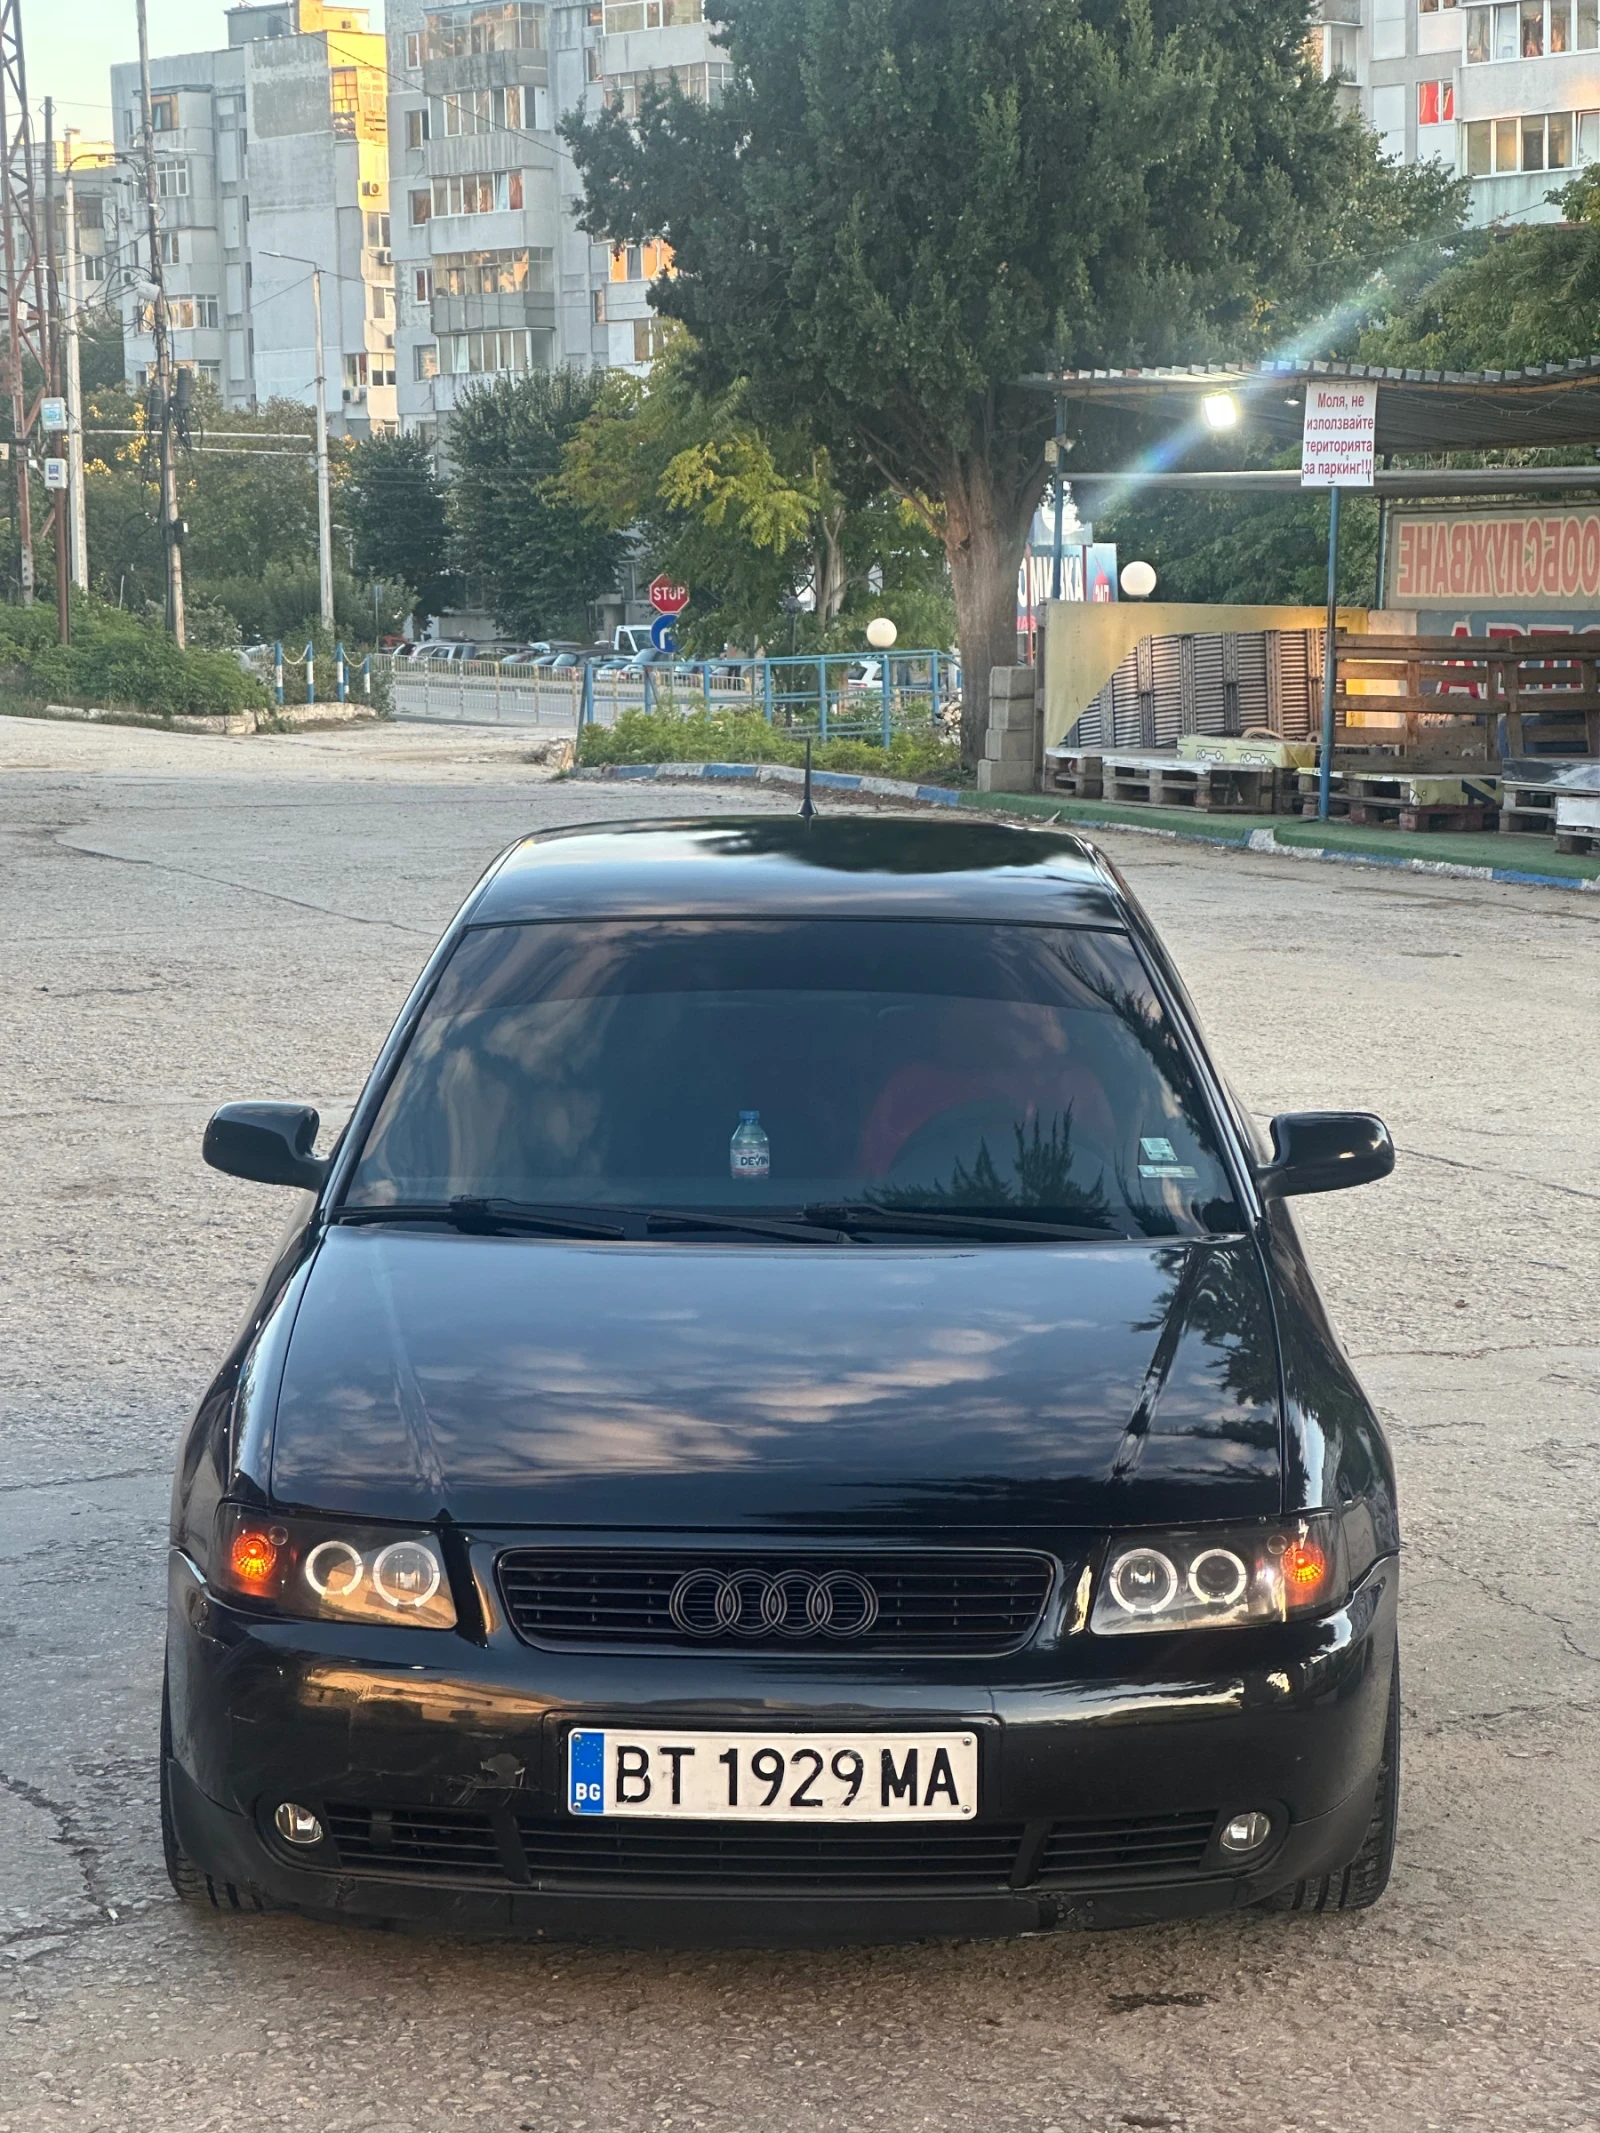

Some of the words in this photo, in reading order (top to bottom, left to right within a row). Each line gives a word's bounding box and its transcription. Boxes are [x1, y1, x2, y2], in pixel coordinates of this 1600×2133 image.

[1317, 393, 1348, 410] Моля,
[1351, 395, 1364, 407] не
[1306, 414, 1374, 430] използвайте
[1305, 440, 1372, 456] територията
[1304, 463, 1315, 474] за
[1318, 459, 1372, 478] паркинг!!!
[653, 586, 686, 601] STOP
[740, 1154, 769, 1167] DEVIN
[719, 1747, 864, 1807] 1929
[881, 1748, 960, 1807] MA
[575, 1783, 601, 1801] BG
